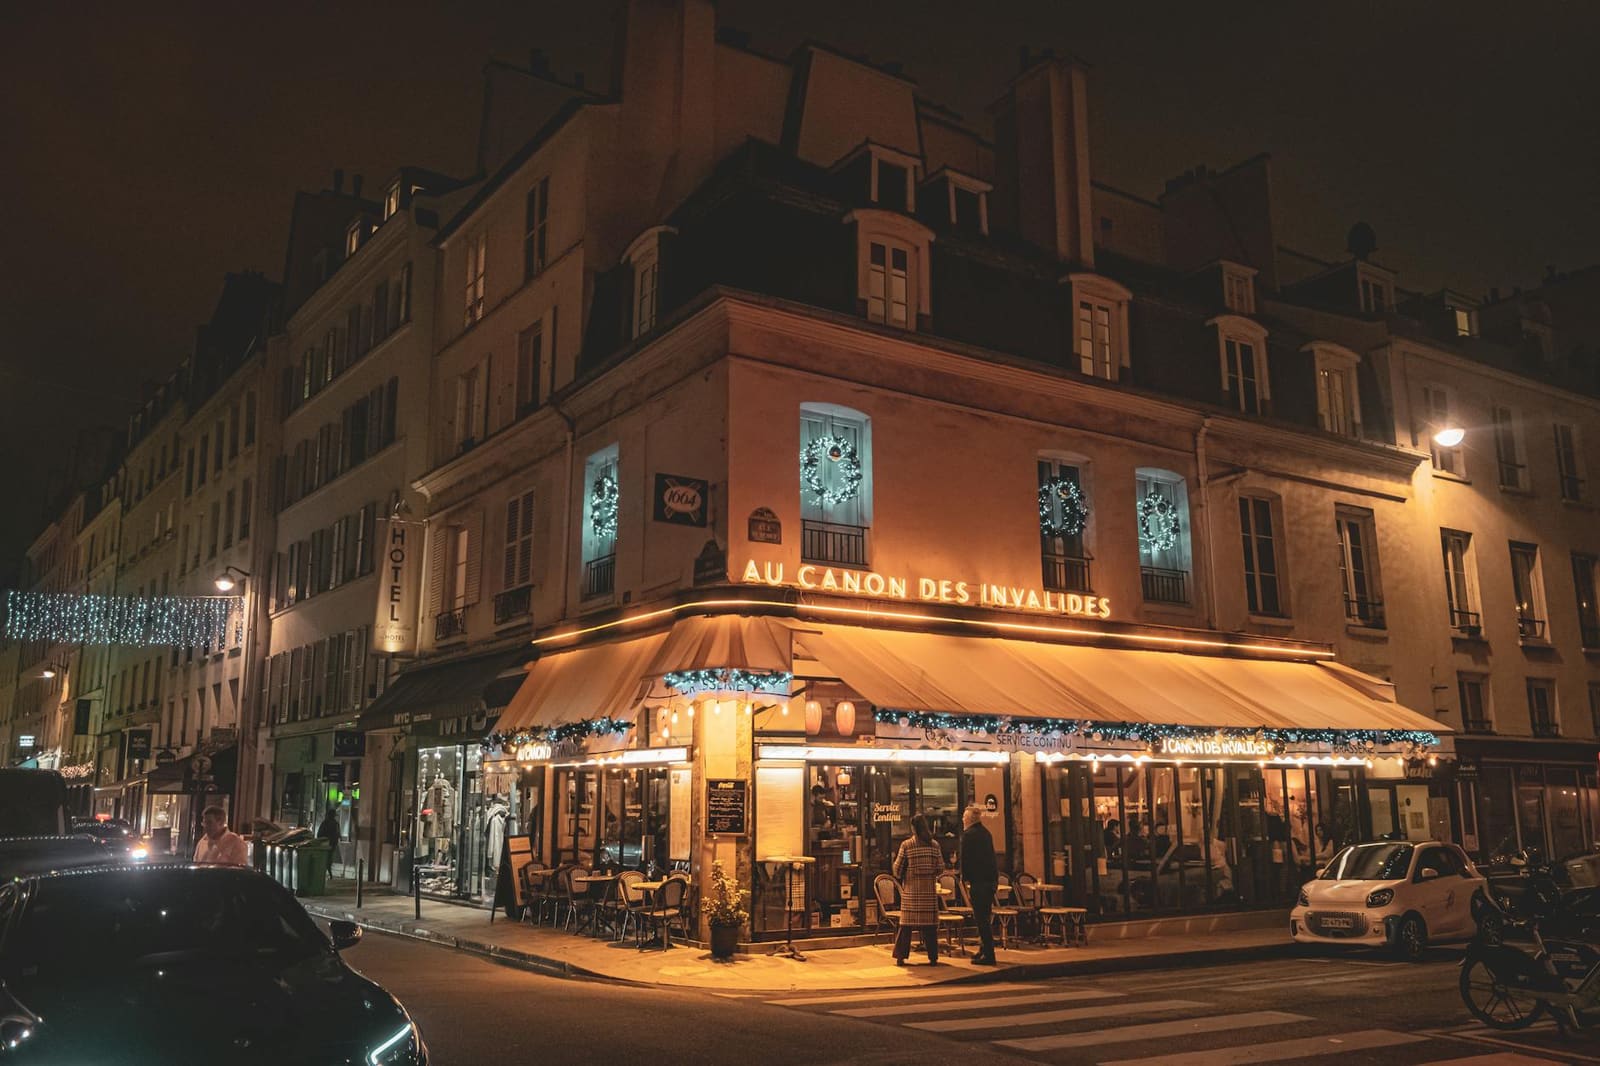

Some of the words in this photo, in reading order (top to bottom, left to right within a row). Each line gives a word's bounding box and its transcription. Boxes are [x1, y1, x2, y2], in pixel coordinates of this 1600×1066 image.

[668, 489, 697, 507] 1664
[390, 528, 405, 622] HOTEL
[742, 559, 784, 586] AU
[797, 566, 906, 599] CANON
[919, 577, 969, 604] DES
[980, 583, 1112, 619] INVALIDES
[996, 733, 1031, 747] SERVICE
[1033, 735, 1073, 749] CONTINU
[873, 801, 900, 812] Service
[872, 813, 902, 822] Continu
